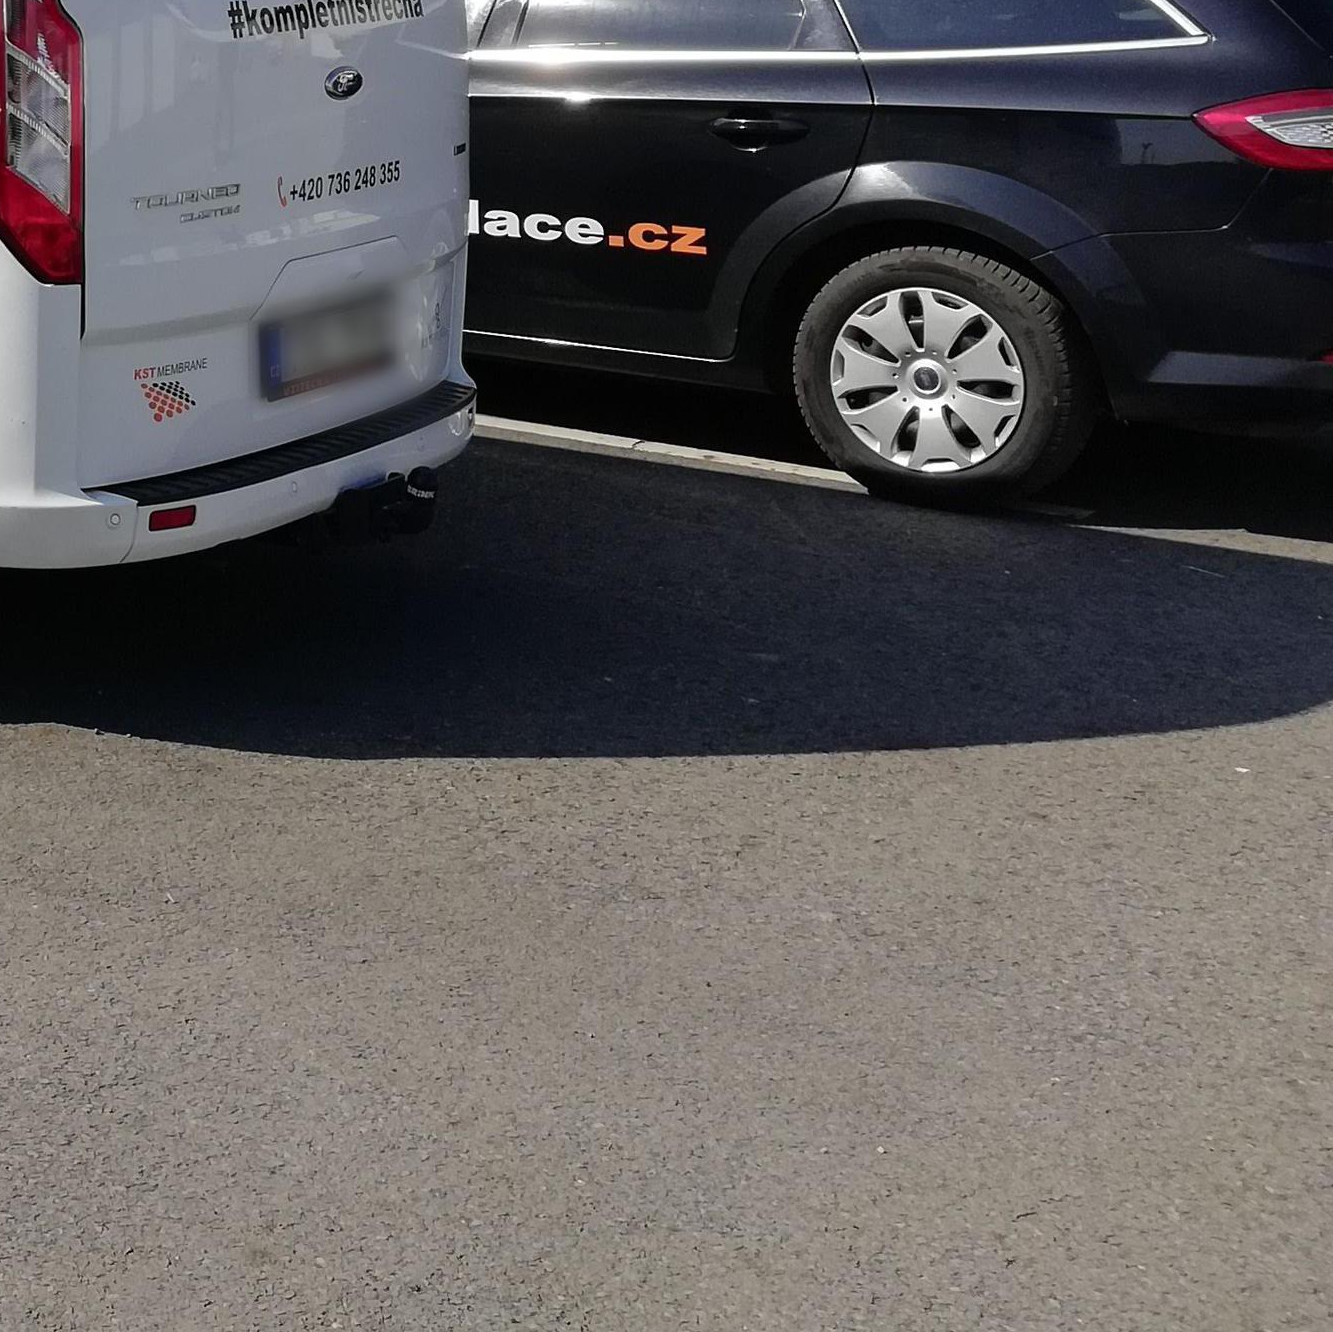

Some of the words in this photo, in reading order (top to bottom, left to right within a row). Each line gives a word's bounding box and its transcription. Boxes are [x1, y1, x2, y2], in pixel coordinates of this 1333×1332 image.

[290, 176, 323, 202] +420
[328, 170, 351, 196] 736
[354, 165, 376, 191] 248
[380, 160, 400, 184] 355
[133, 367, 156, 381] KST
[157, 357, 208, 378] MEMBRANE
